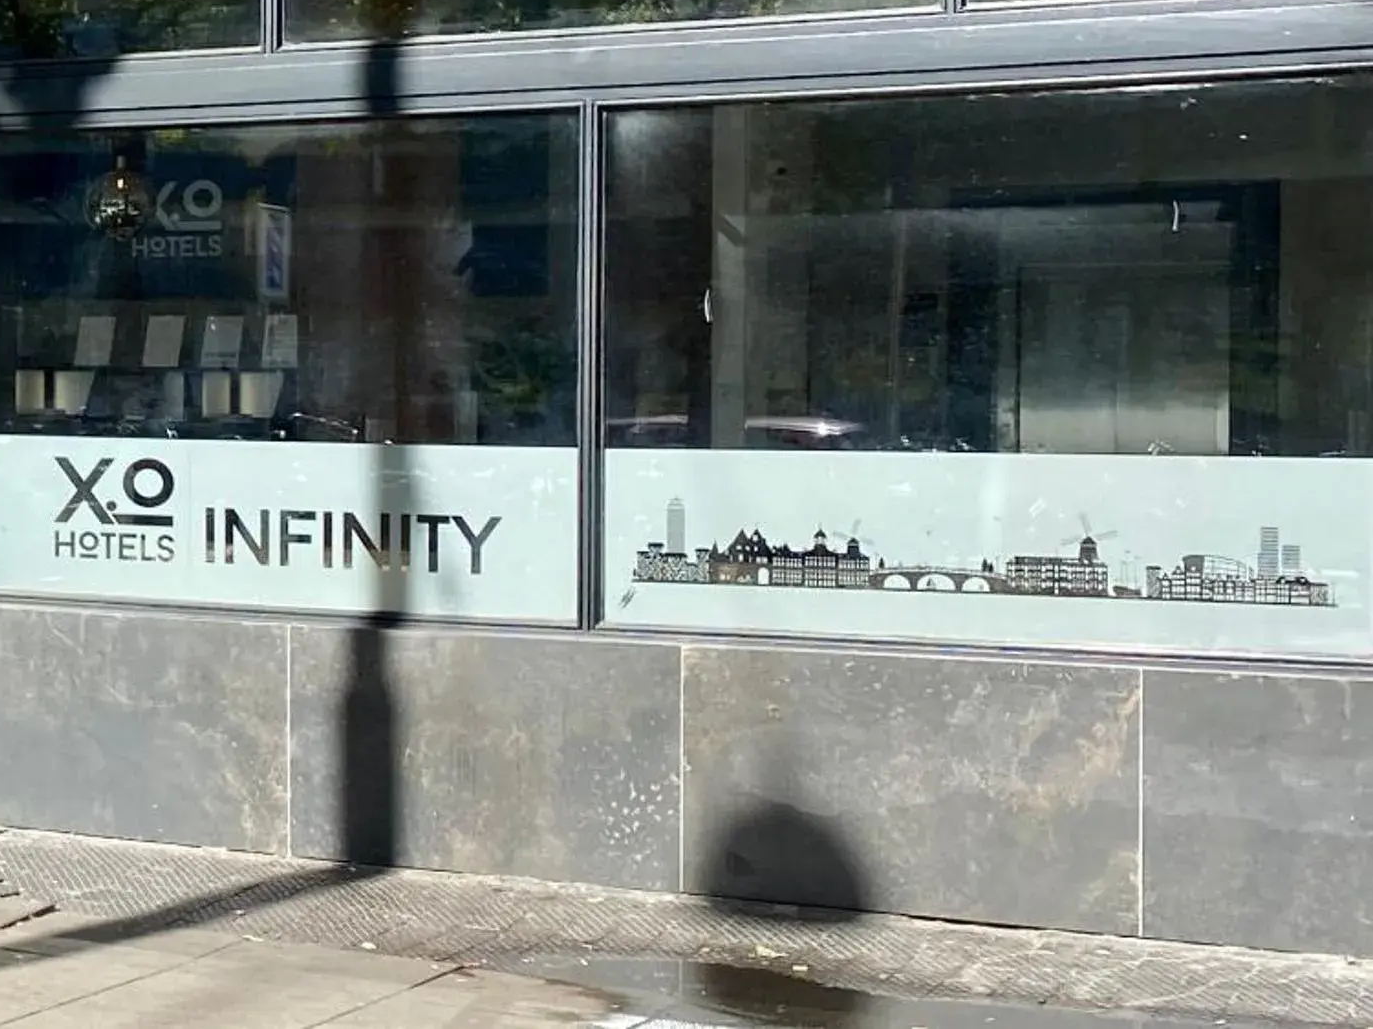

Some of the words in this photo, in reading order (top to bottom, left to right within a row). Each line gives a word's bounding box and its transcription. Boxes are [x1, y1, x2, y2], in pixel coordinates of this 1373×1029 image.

[131, 235, 223, 258] HOTELS
[54, 530, 175, 562] HOTELS
[205, 506, 502, 575] INFINITY
